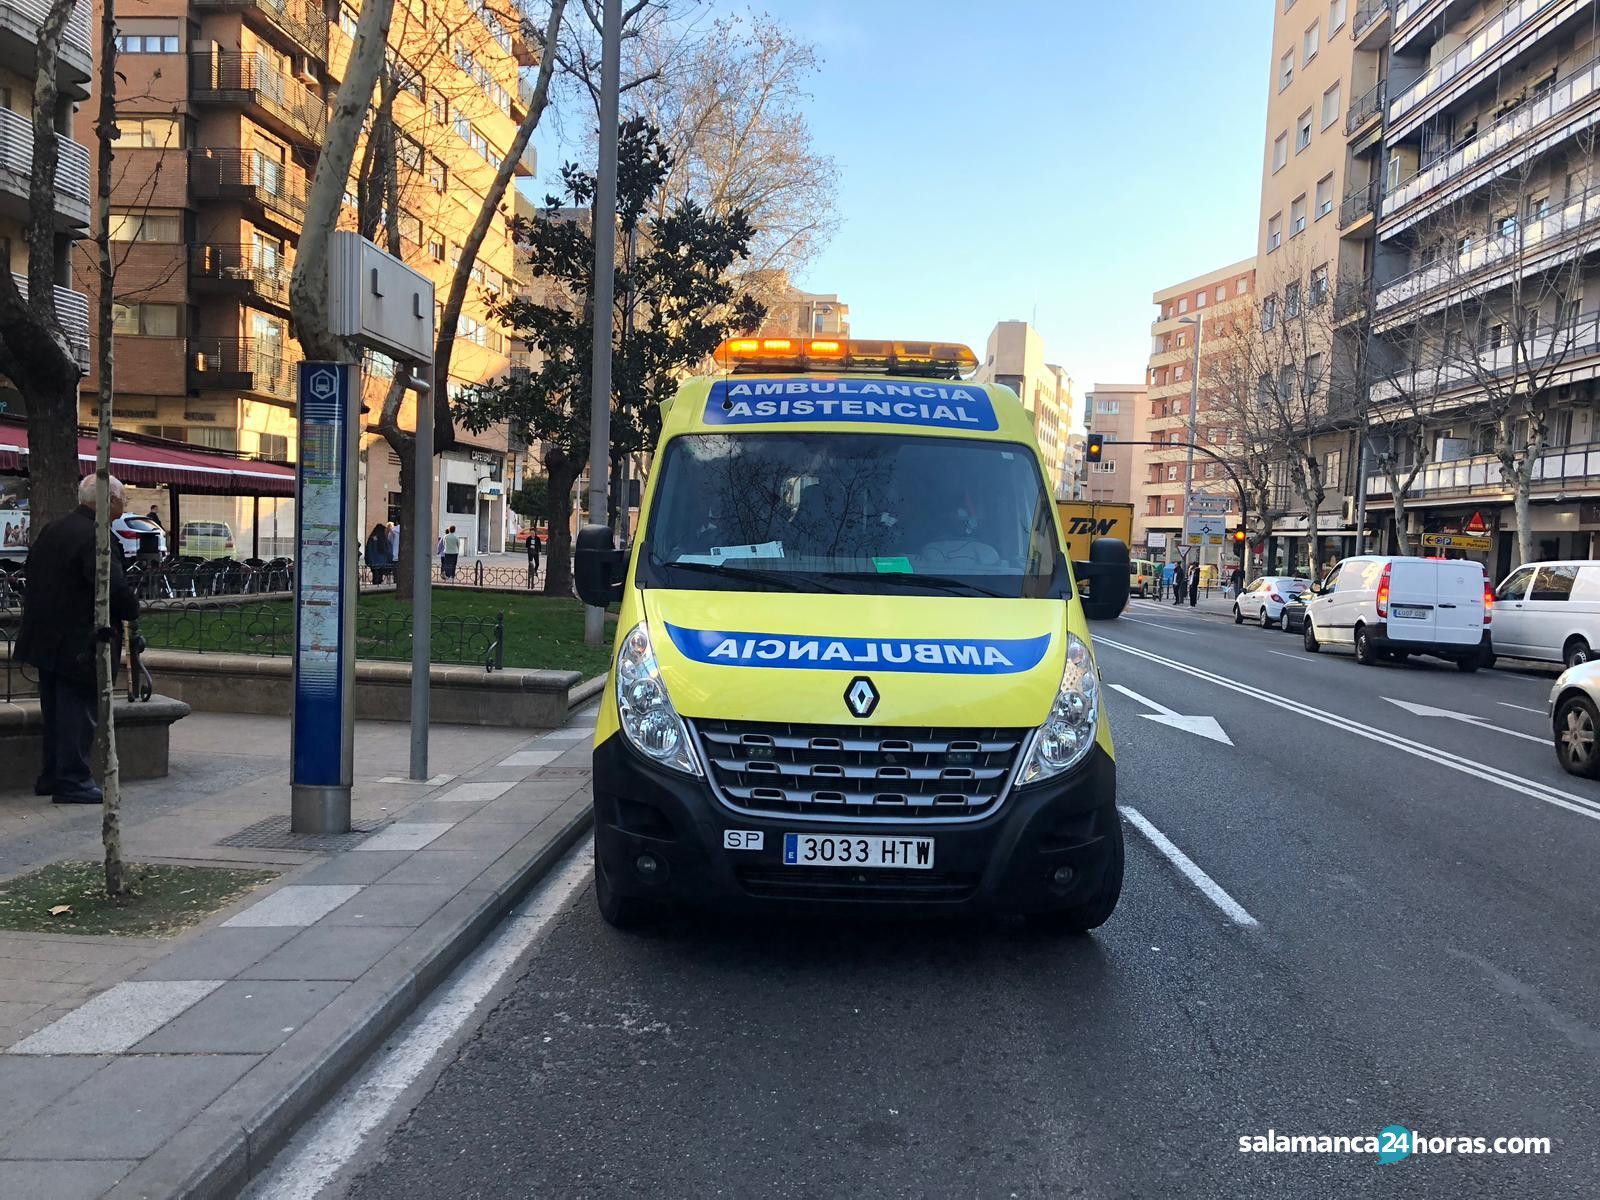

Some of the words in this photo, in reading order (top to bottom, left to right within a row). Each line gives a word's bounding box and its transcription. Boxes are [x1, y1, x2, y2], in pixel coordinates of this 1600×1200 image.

[728, 383, 976, 402] AMBULANCIA
[727, 400, 980, 423] ASISTENCIAL
[1068, 517, 1118, 536] TDN
[727, 831, 760, 848] SP
[788, 851, 794, 859] E
[804, 838, 869, 862] 3033
[881, 840, 931, 865] HTW
